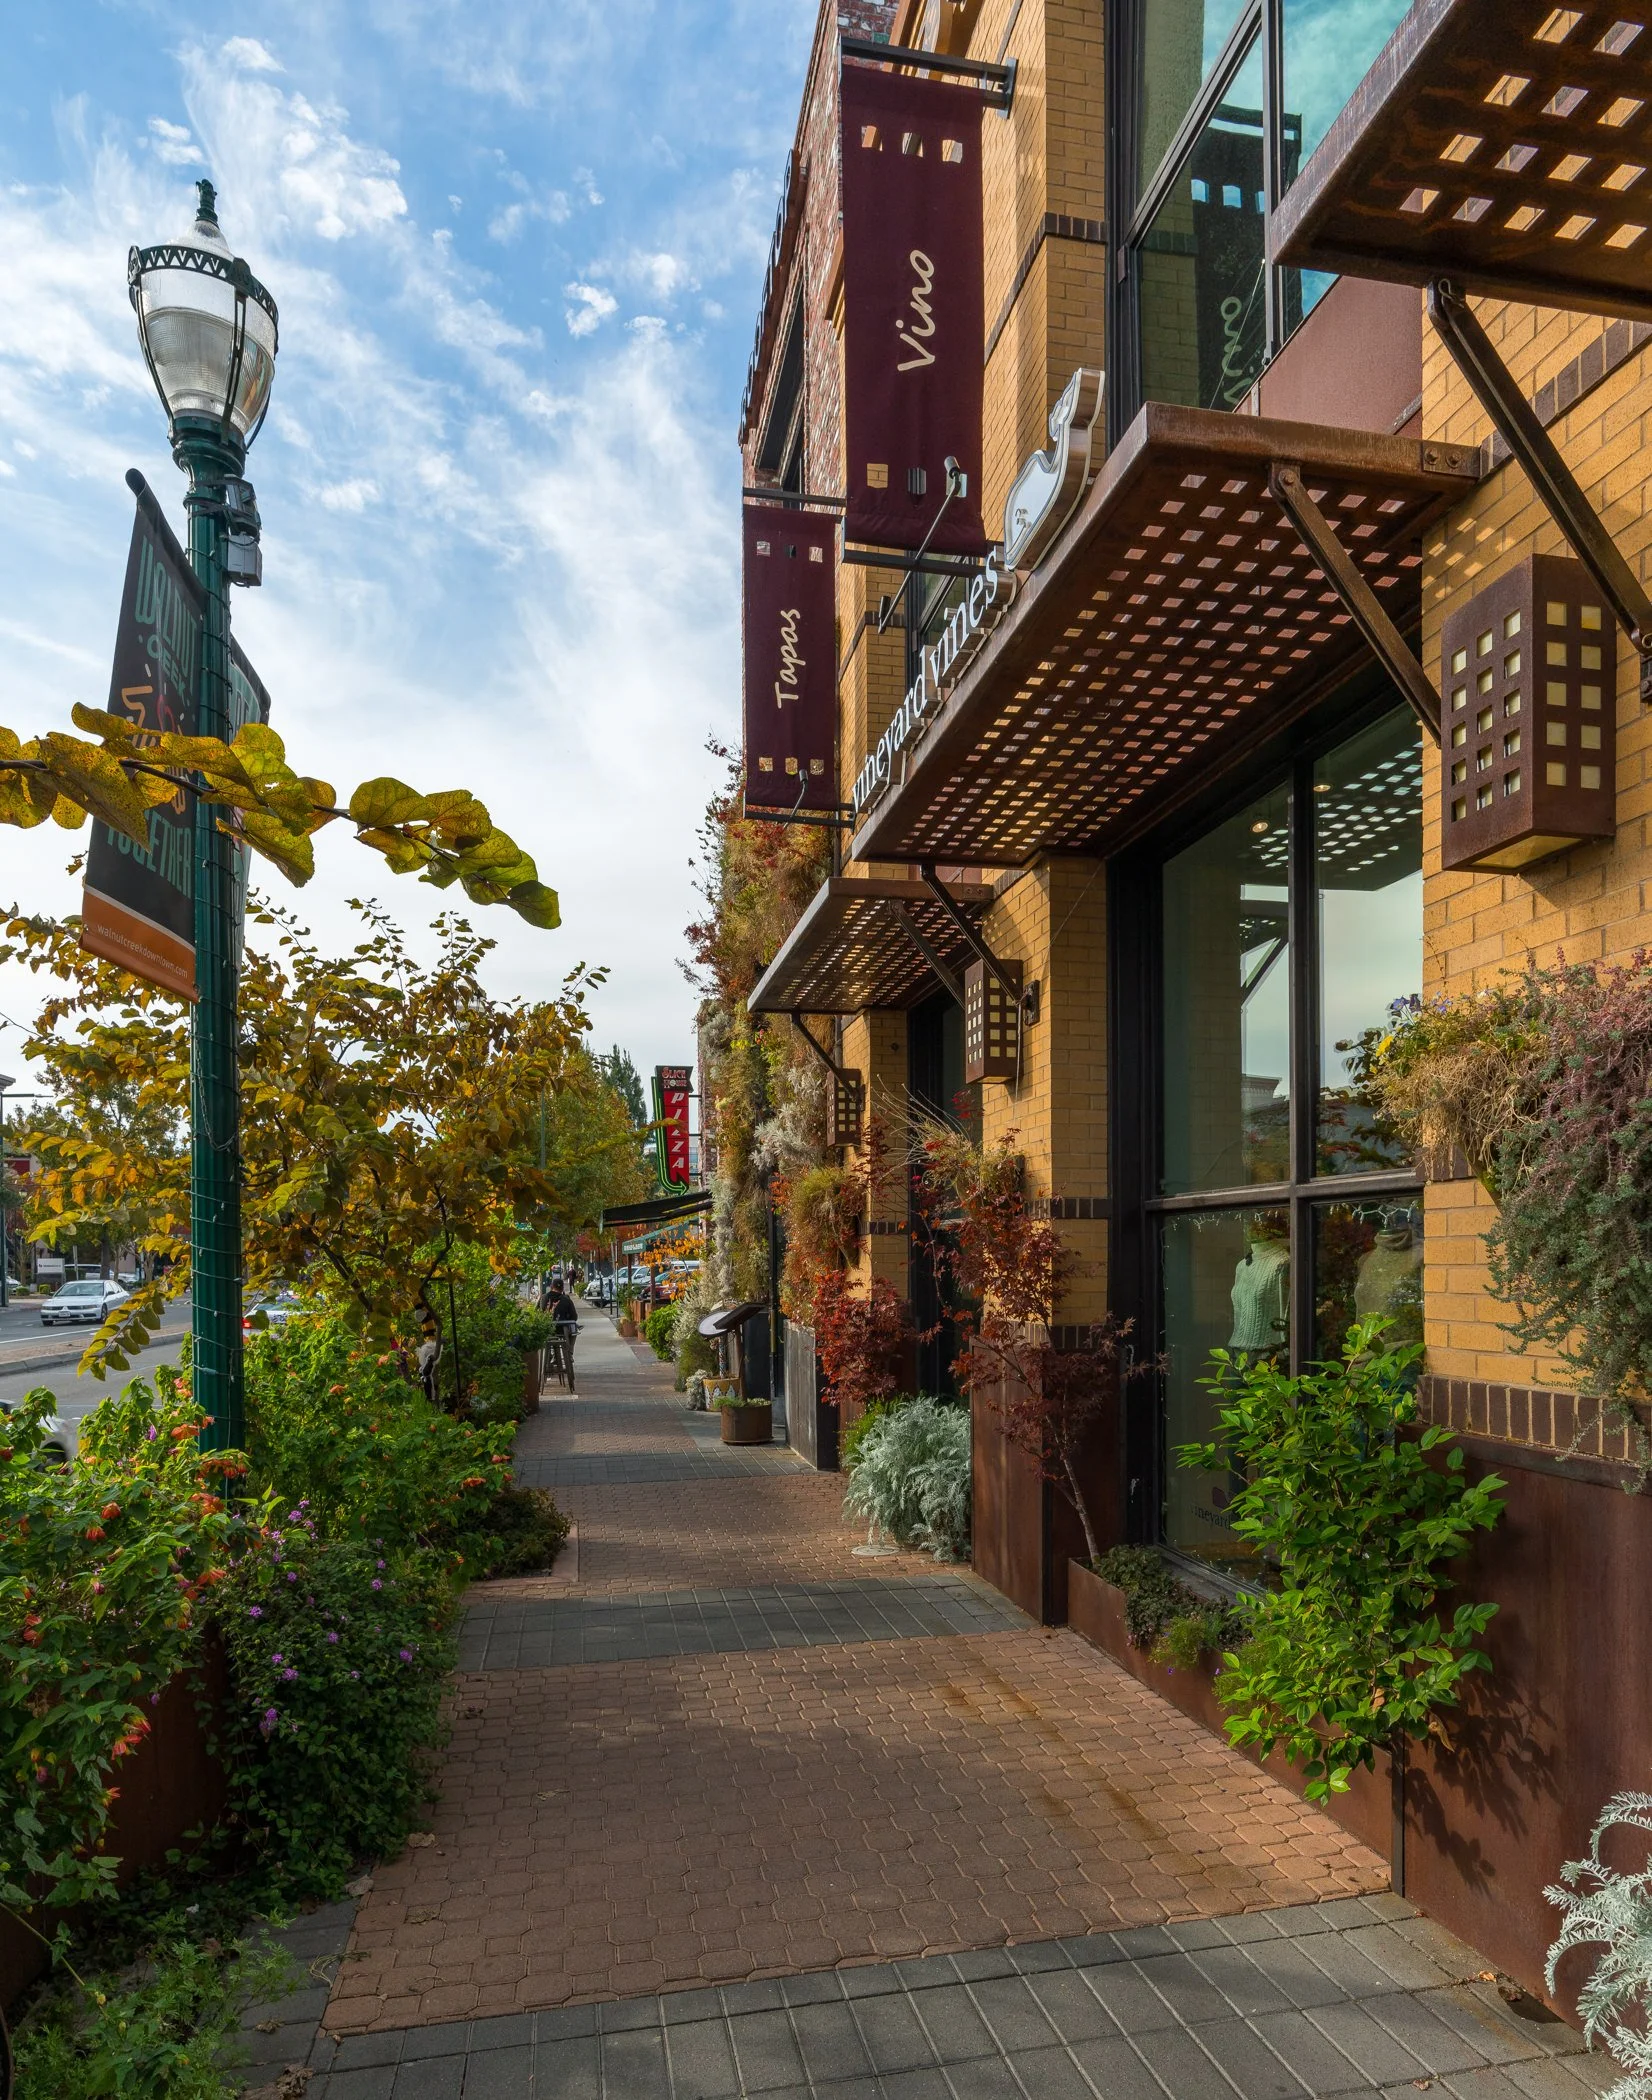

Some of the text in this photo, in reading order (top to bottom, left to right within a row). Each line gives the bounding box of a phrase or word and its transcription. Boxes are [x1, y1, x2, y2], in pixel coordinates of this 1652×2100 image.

[897, 248, 936, 372] Vino
[135, 535, 198, 697] WALNUT
[147, 634, 186, 706] CEEK
[774, 608, 806, 709] Tapas
[852, 545, 998, 814] vineyard vines
